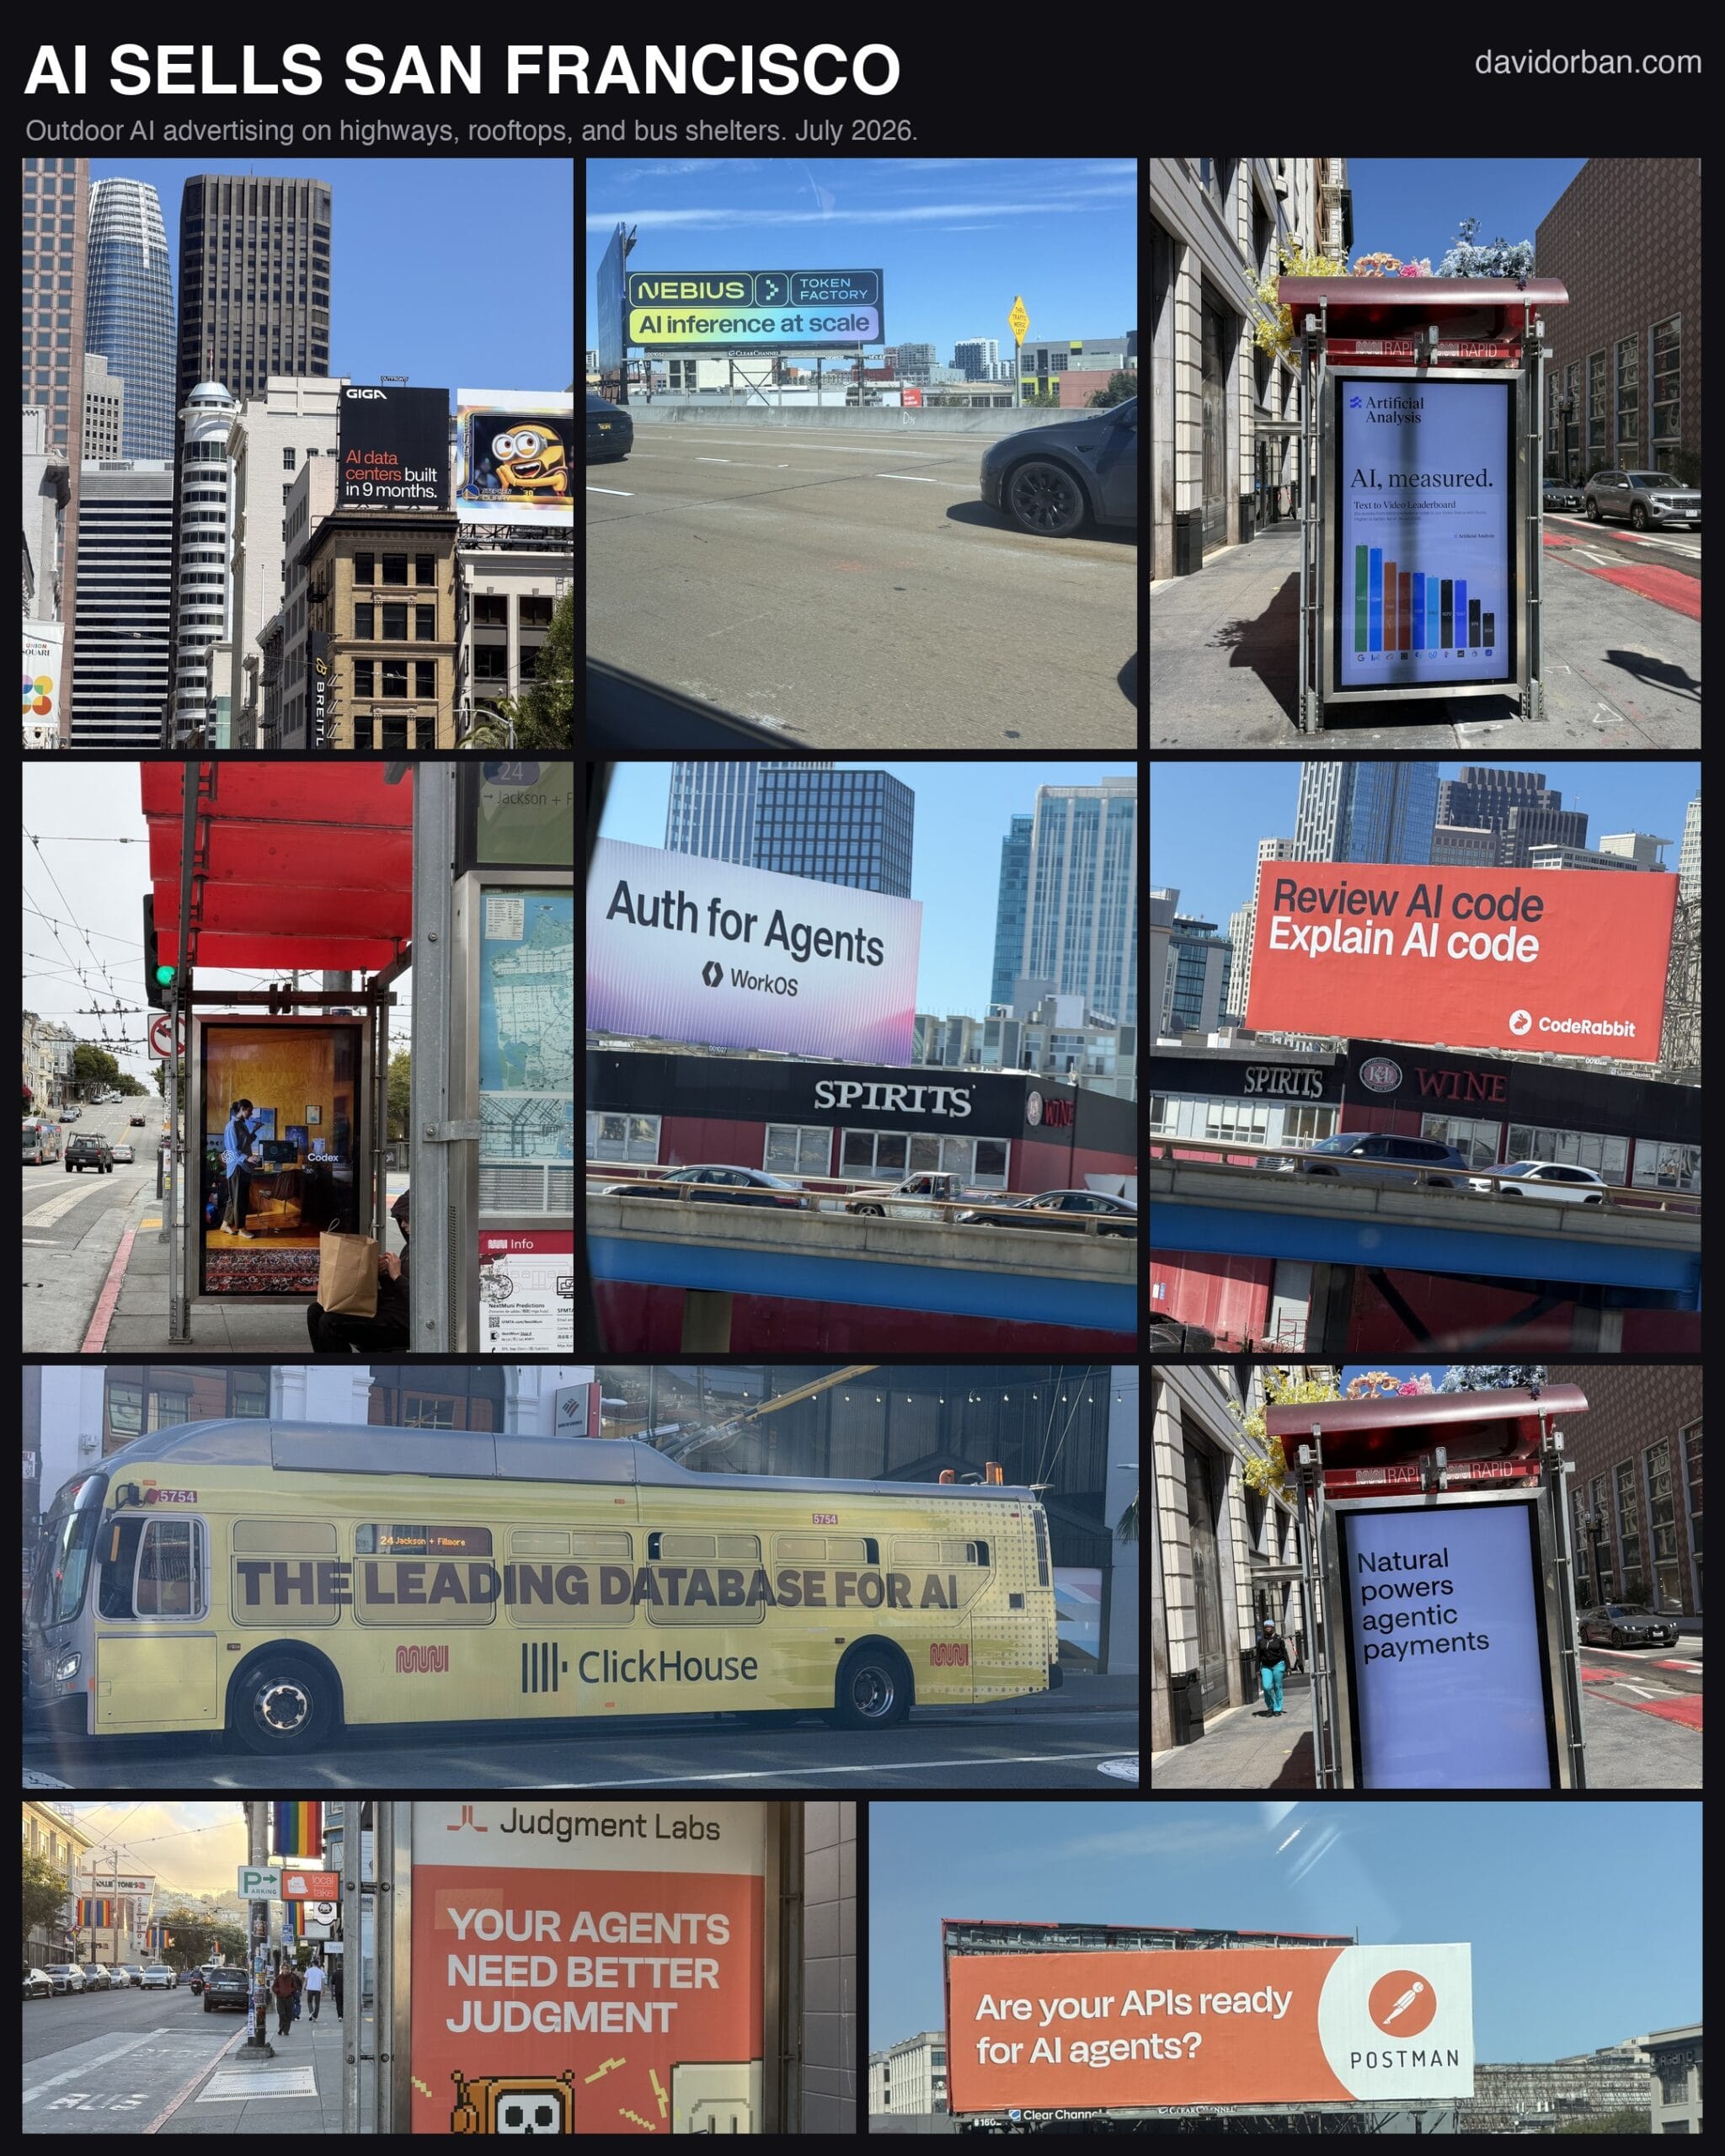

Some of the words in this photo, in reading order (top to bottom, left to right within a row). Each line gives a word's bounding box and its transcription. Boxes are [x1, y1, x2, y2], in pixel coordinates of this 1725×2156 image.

[638, 281, 745, 300] NEBIUS
[800, 278, 851, 288] TOKEN
[800, 290, 868, 300] FACTORY
[639, 315, 661, 334] AI
[667, 315, 776, 334] inference
[781, 315, 804, 333] at
[809, 313, 870, 332] scale
[1384, 341, 1413, 355] RAPI
[1461, 343, 1498, 358] RAPID
[346, 389, 387, 399] GIGA
[1365, 396, 1423, 409] Artificial
[1365, 411, 1422, 425] Analysis
[346, 449, 361, 464] AI
[364, 450, 398, 465] data
[345, 467, 402, 482] centers
[405, 467, 437, 483] built
[1350, 468, 1382, 490] AI,
[1388, 468, 1493, 488] measured.
[346, 482, 360, 496] in
[362, 483, 373, 497] 9
[376, 483, 437, 499] months.
[1408, 500, 1455, 509] Leaderboard
[500, 761, 524, 781] 24
[497, 790, 547, 805] Jackson
[1274, 878, 1400, 917] Review
[1406, 883, 1443, 919] AI
[1451, 886, 1544, 923] code
[606, 878, 699, 934] Auth
[707, 897, 758, 943] for
[763, 909, 884, 967] Agents
[1269, 915, 1394, 958] Explain
[1402, 922, 1439, 958] AI
[1446, 926, 1540, 963] code
[731, 968, 798, 996] WorkOS
[1538, 1017, 1636, 1038] CodeRabbit
[1243, 1065, 1323, 1100] SPIRITS
[1414, 1066, 1509, 1102] WINE
[814, 1080, 972, 1118] SPIRITS
[1044, 1098, 1075, 1129] WINE
[307, 1153, 339, 1162] Codex
[510, 1238, 534, 1249] Info
[1388, 1467, 1419, 1484] RAPI
[1472, 1461, 1514, 1480] RAPID
[159, 1491, 196, 1503] 5754
[813, 1514, 837, 1524] 5754
[380, 1536, 393, 1545] 24
[395, 1536, 425, 1545] Jackson
[437, 1537, 466, 1546] Fillmore
[1358, 1547, 1449, 1573] Natural
[237, 1561, 352, 1605] THE
[365, 1561, 590, 1606] LEADING
[600, 1566, 828, 1608] DATABASE
[835, 1570, 912, 1609] FOR
[920, 1574, 959, 1609] AI
[1361, 1579, 1454, 1606] powers
[1362, 1604, 1458, 1635] agentic
[1364, 1631, 1490, 1665] payments
[578, 1649, 759, 1684] ClickHouse
[499, 1806, 647, 1843] Judgment
[655, 1812, 720, 1841] Labs
[312, 1875, 334, 1885] local
[446, 1908, 562, 1942] YOUR
[569, 1911, 730, 1945] AGENTS
[447, 1954, 558, 1988] NEED
[566, 1956, 719, 1990] BETTER
[975, 1993, 1033, 2020] Are
[1039, 1994, 1114, 2027] your
[1120, 1988, 1193, 2017] APIs
[1199, 1985, 1294, 2020] ready
[446, 2000, 678, 2034] JUDGMENT
[975, 2036, 1024, 2064] for
[1029, 2036, 1061, 2063] AI
[1069, 2031, 1203, 2068] agents?
[1350, 2048, 1460, 2069] POSTMAN
[1023, 2110, 1054, 2121] Clear
